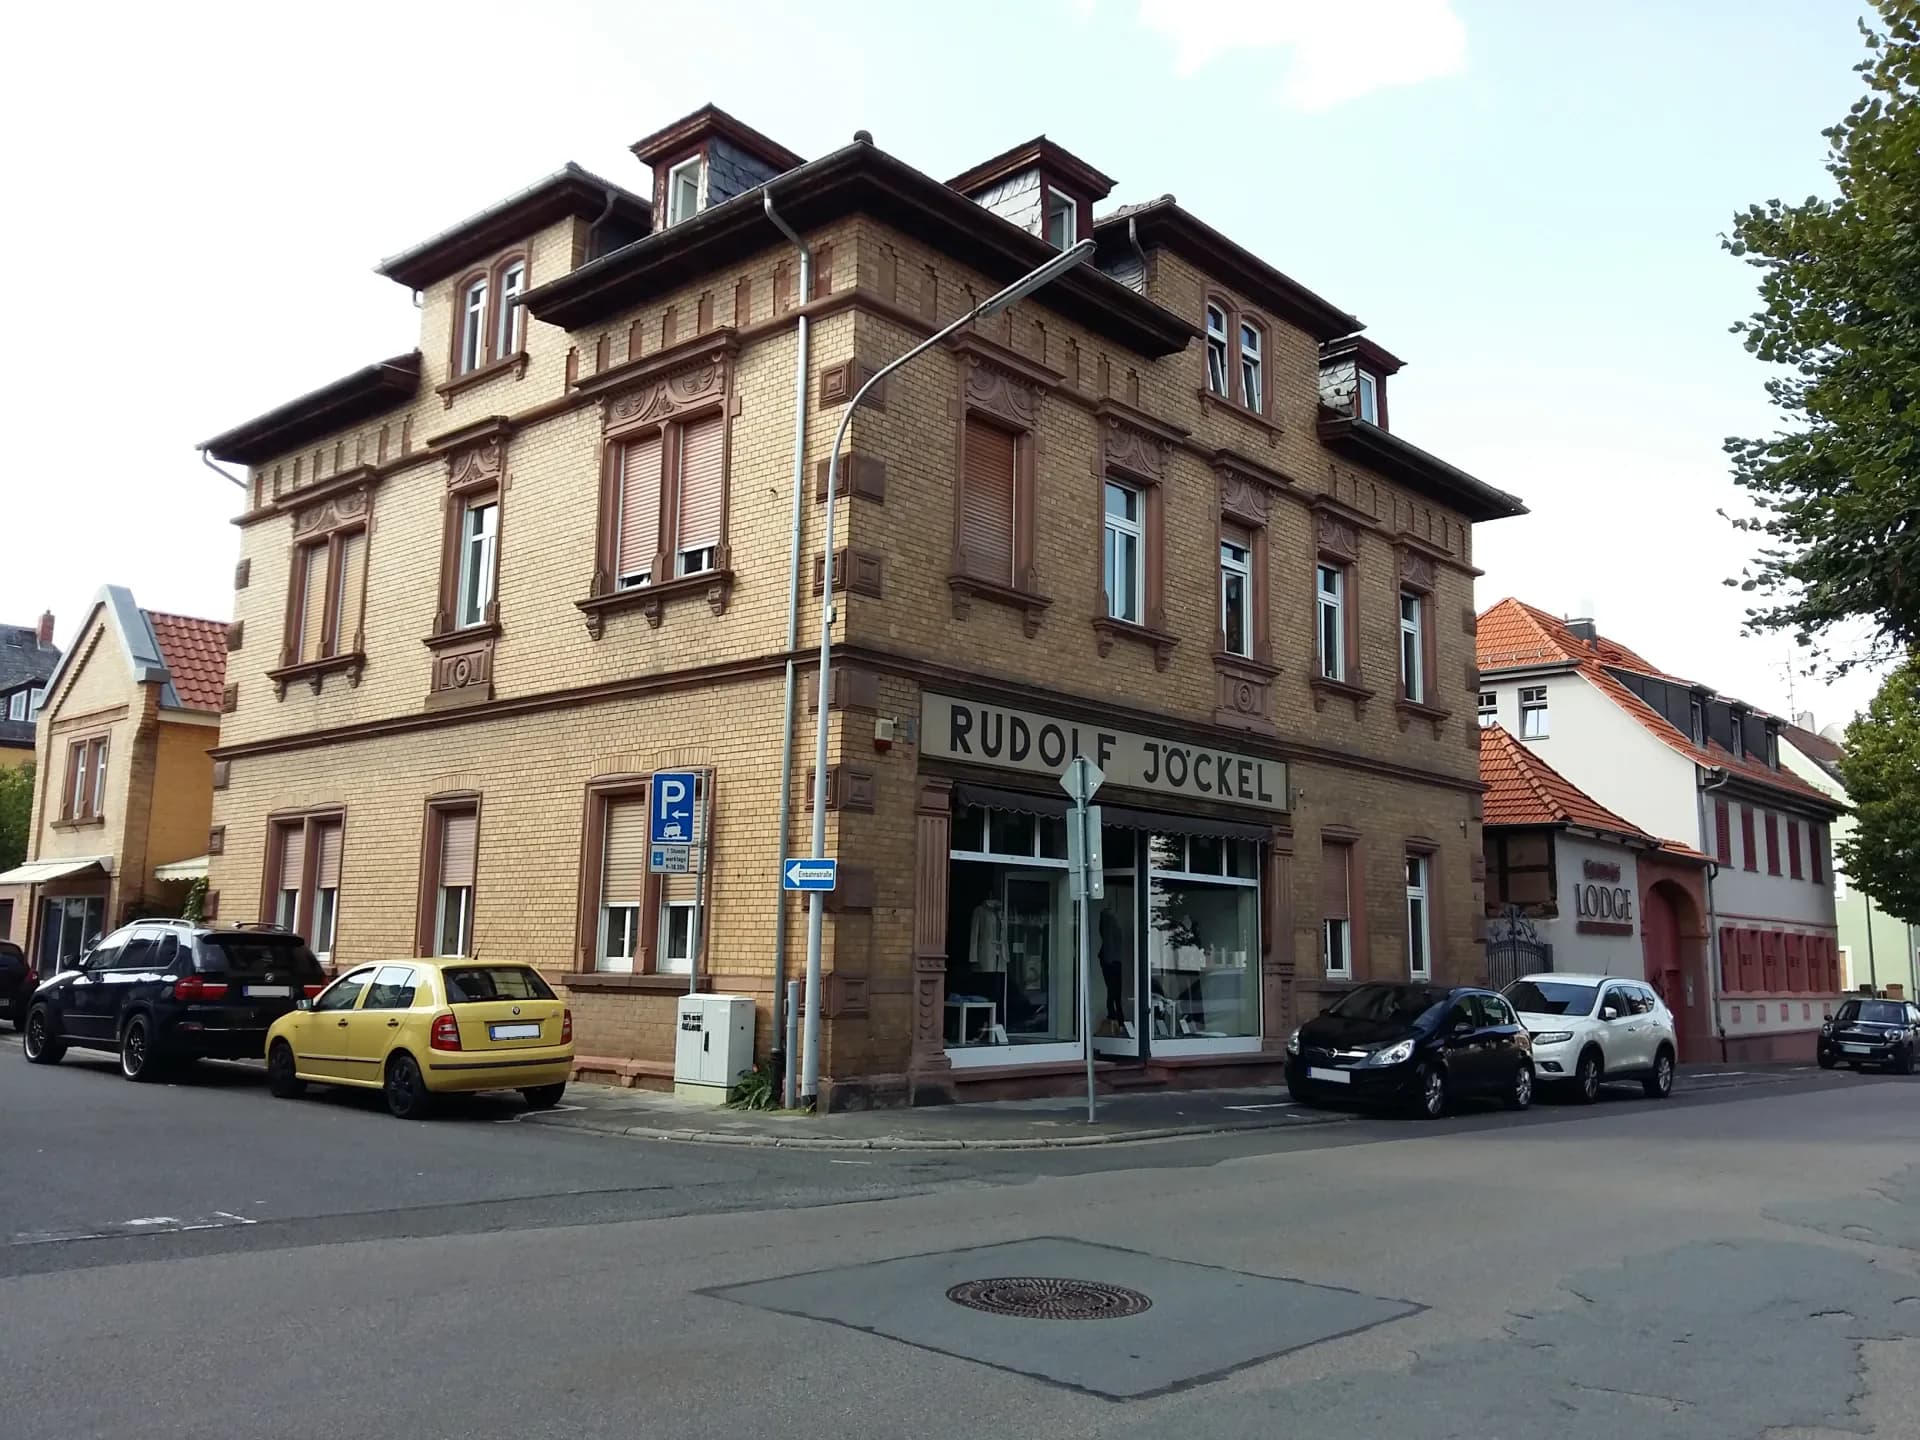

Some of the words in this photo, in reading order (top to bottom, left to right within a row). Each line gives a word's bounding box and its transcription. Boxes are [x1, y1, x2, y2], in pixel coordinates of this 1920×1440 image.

[950, 704, 1116, 772] RUDOLF
[1143, 742, 1272, 803] JÖCKEL
[661, 780, 686, 820] P
[799, 870, 833, 878] Einbahnstraße
[1575, 883, 1633, 920] LODGE
